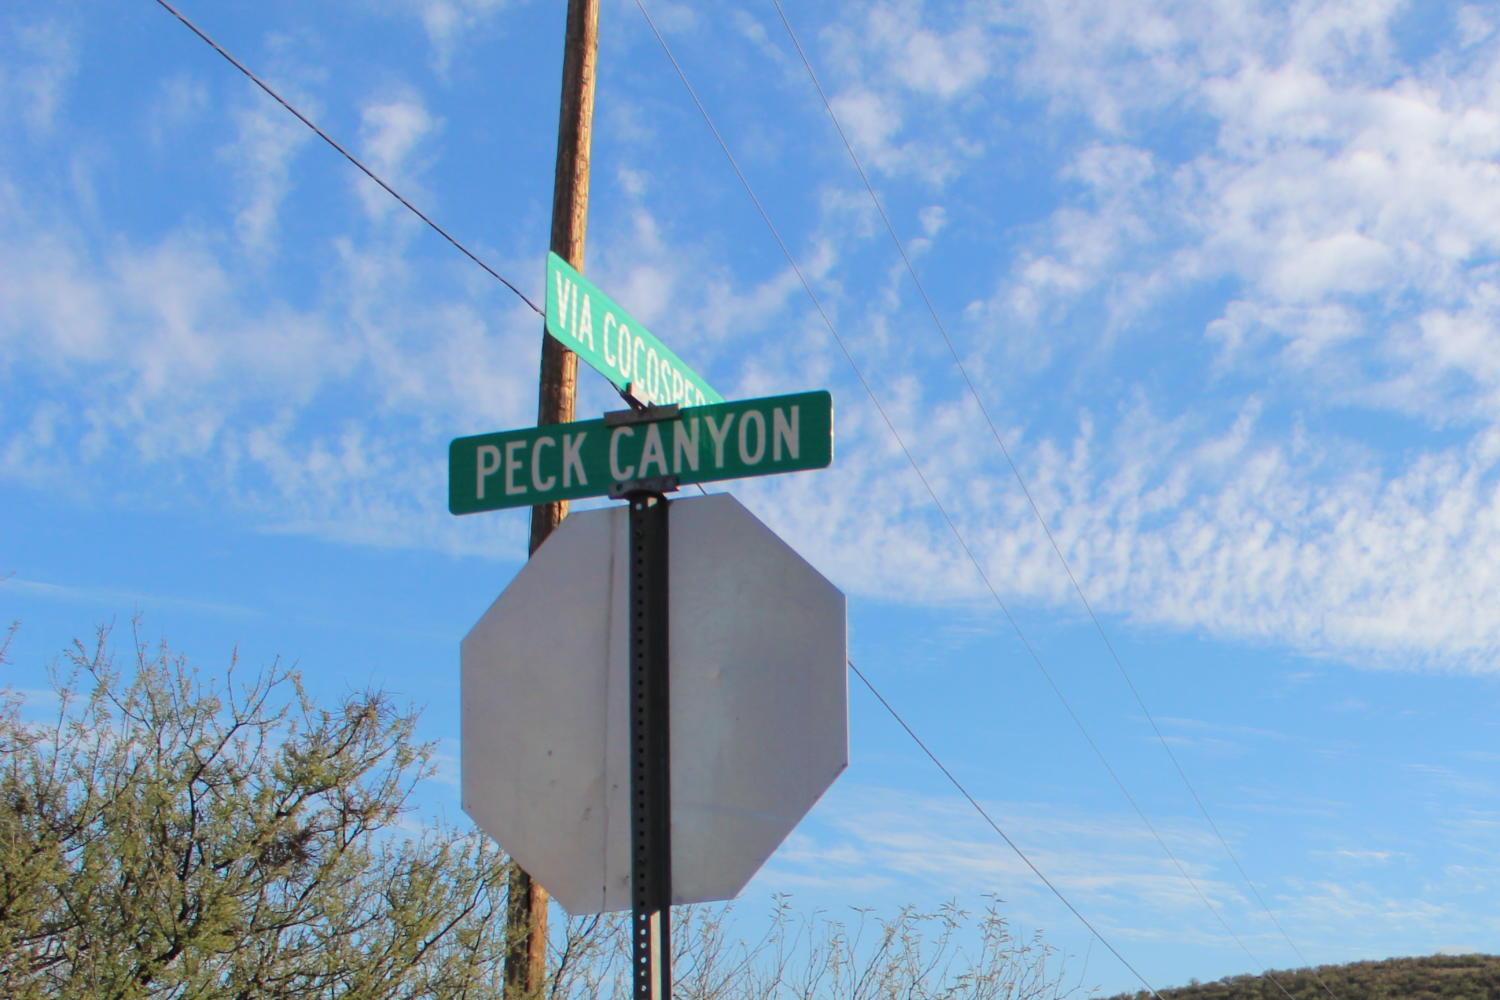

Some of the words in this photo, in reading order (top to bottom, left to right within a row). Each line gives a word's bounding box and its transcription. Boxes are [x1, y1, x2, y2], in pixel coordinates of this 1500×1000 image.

[556, 270, 594, 352] VIA
[603, 311, 714, 408] COCOSPE
[476, 432, 587, 500] PECK
[609, 405, 800, 481] CANYON
